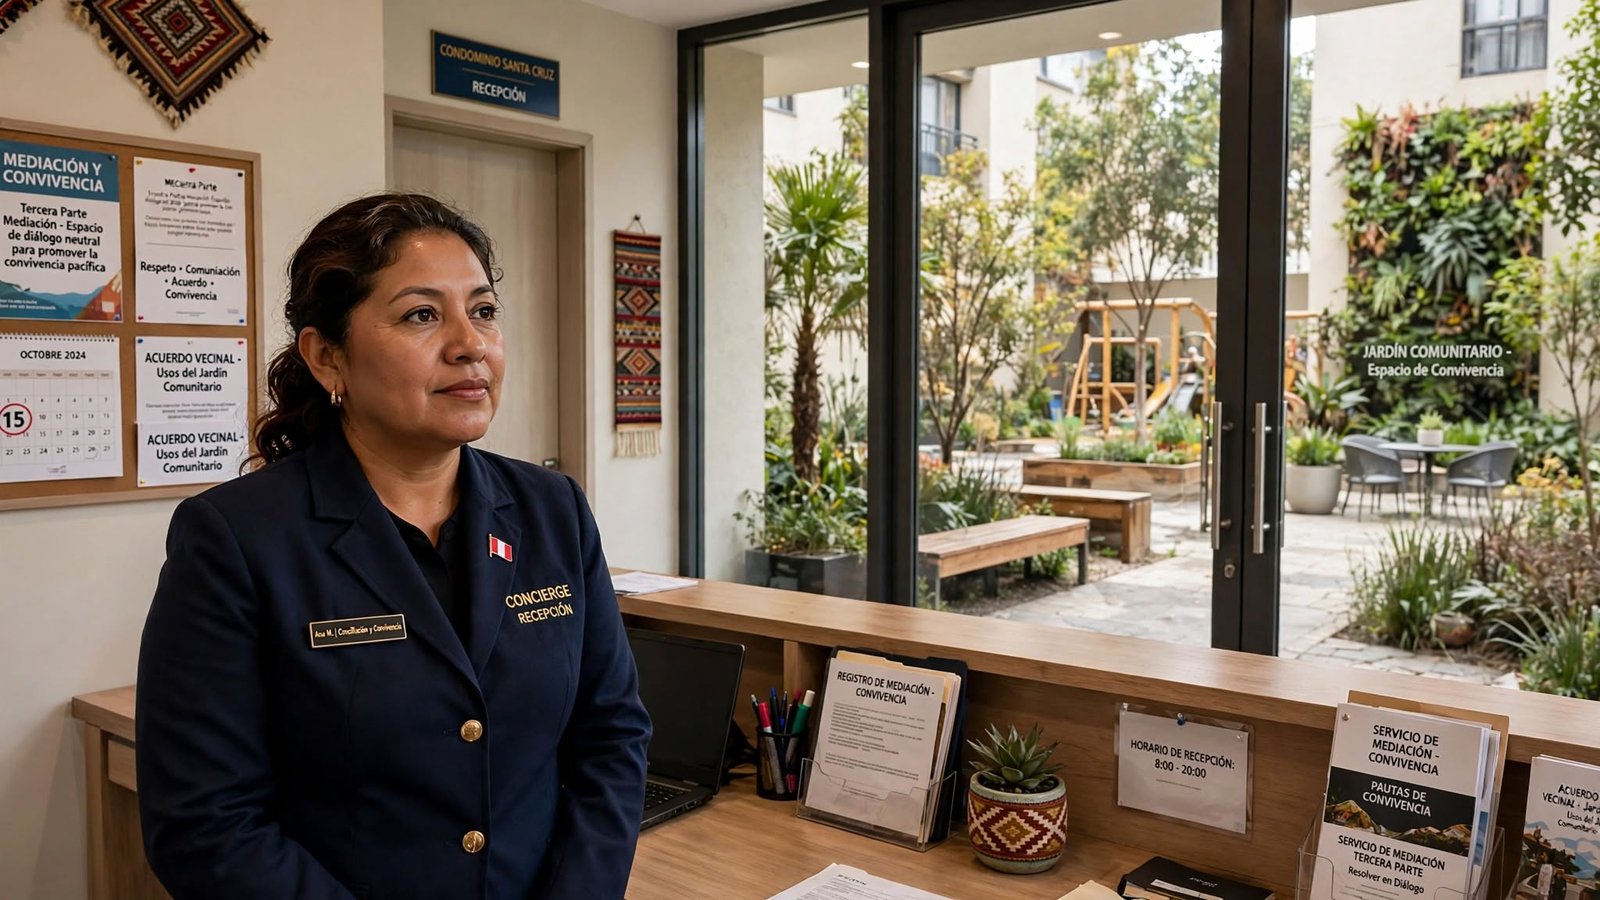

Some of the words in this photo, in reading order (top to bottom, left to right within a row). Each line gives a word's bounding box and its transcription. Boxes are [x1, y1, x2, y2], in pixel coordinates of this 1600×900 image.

[440, 43, 501, 68] CONDOMINIO
[502, 57, 530, 75] SANTA
[532, 65, 554, 81] CRUZ
[472, 80, 527, 103] RECEPCIÓN
[3, 152, 88, 175] MEDIACIÓN
[92, 162, 102, 176] Y
[3, 169, 105, 193] CONVIVENCIA
[20, 202, 58, 216] Tercera
[60, 206, 87, 219] Parte
[3, 215, 57, 230] Mediación
[66, 220, 104, 234] Espacio
[8, 229, 21, 240] de
[23, 229, 63, 246] diálogo
[64, 236, 101, 246] neutral
[12, 245, 36, 256] para
[38, 247, 87, 259] promover
[89, 248, 98, 259] la
[4, 257, 65, 270] convivencia
[67, 260, 106, 273] pacífica
[140, 261, 177, 274] Respeto
[185, 264, 241, 277] Comuniación
[171, 276, 208, 288] Acuerdo
[165, 288, 218, 301] Convivencia
[20, 350, 62, 359] OCTOBRE
[64, 350, 87, 360] 2024
[144, 352, 193, 364] ACUERDO
[194, 353, 235, 364] VECINAL
[1363, 343, 1407, 359] JARDÍN
[1410, 344, 1503, 359] COMUNITARIO
[156, 367, 180, 378] Usos
[181, 367, 197, 378] del
[198, 367, 228, 378] Jardín
[1367, 363, 1412, 379] Espacio
[1413, 363, 1429, 376] de
[1431, 363, 1504, 377] Convivencia
[163, 381, 223, 392] Comunitario
[2, 411, 25, 428] 15
[147, 433, 196, 446] ACUERDO
[198, 431, 239, 443] VECINAL
[156, 449, 180, 459] Usos
[181, 447, 197, 458] del
[198, 446, 229, 457] Jardín
[163, 460, 223, 473] Comunitario
[505, 584, 572, 609] CONCIERGE
[517, 601, 574, 624] RECEPCIÓN
[837, 671, 873, 686] REGISTRO
[875, 677, 885, 687] DE
[886, 680, 930, 696] MEDIACIÓN
[856, 687, 907, 705] CONVIVENCIA
[1373, 725, 1421, 743] SERVICIO
[1423, 734, 1439, 746] DE
[1130, 739, 1169, 756] HORARIO
[1170, 747, 1182, 759] DE
[1184, 749, 1235, 770] RECEPCIÓN:
[1372, 739, 1432, 760] MEDIACIÓN
[1154, 758, 1174, 772] 8:00
[1181, 764, 1207, 779] 20:00
[1368, 752, 1439, 776] CONVIVENCIA
[1371, 781, 1410, 798] PAUTAS
[1412, 790, 1427, 802] DE
[1542, 791, 1575, 808] VECINAL
[1558, 784, 1599, 802] ACUERDO
[1362, 791, 1431, 817] CONVIVENCIA
[1338, 835, 1377, 853] SERVICIO
[1379, 845, 1391, 856] DE
[1392, 848, 1445, 871] MEDIACIÓN
[1354, 851, 1392, 870] TERCERA
[1394, 861, 1424, 878] PARTE
[1348, 865, 1381, 883] Resolver
[1382, 875, 1393, 885] en
[1394, 877, 1425, 895] Diálogo
